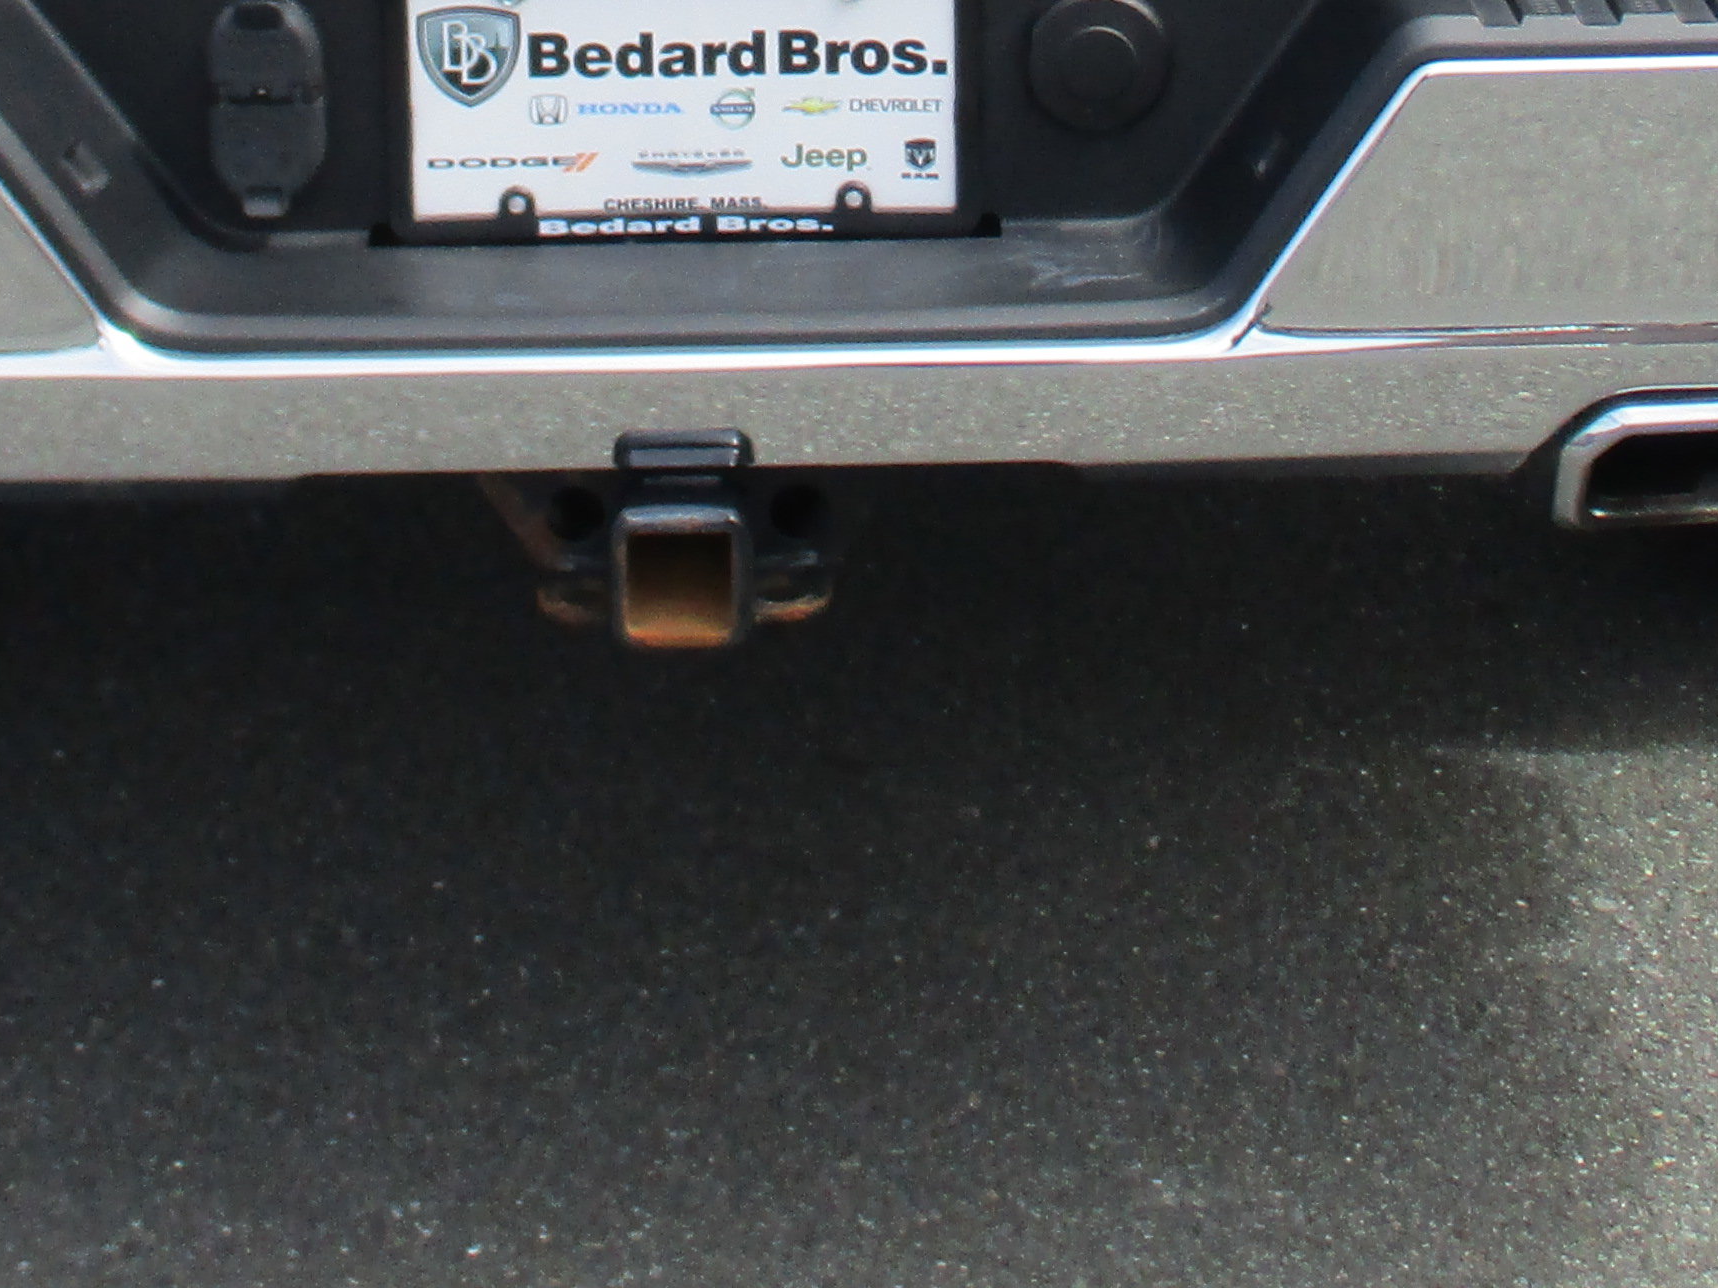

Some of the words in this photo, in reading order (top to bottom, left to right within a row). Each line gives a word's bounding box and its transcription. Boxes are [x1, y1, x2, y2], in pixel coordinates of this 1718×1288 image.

[527, 31, 767, 79] Bedard
[778, 29, 949, 76] Bros.
[576, 103, 685, 115] HONDA
[849, 99, 943, 112] CHEVROLET
[427, 156, 576, 169] DODGE
[781, 144, 867, 171] Jeep
[538, 217, 702, 237] Bedard
[717, 215, 835, 234] Bros.
